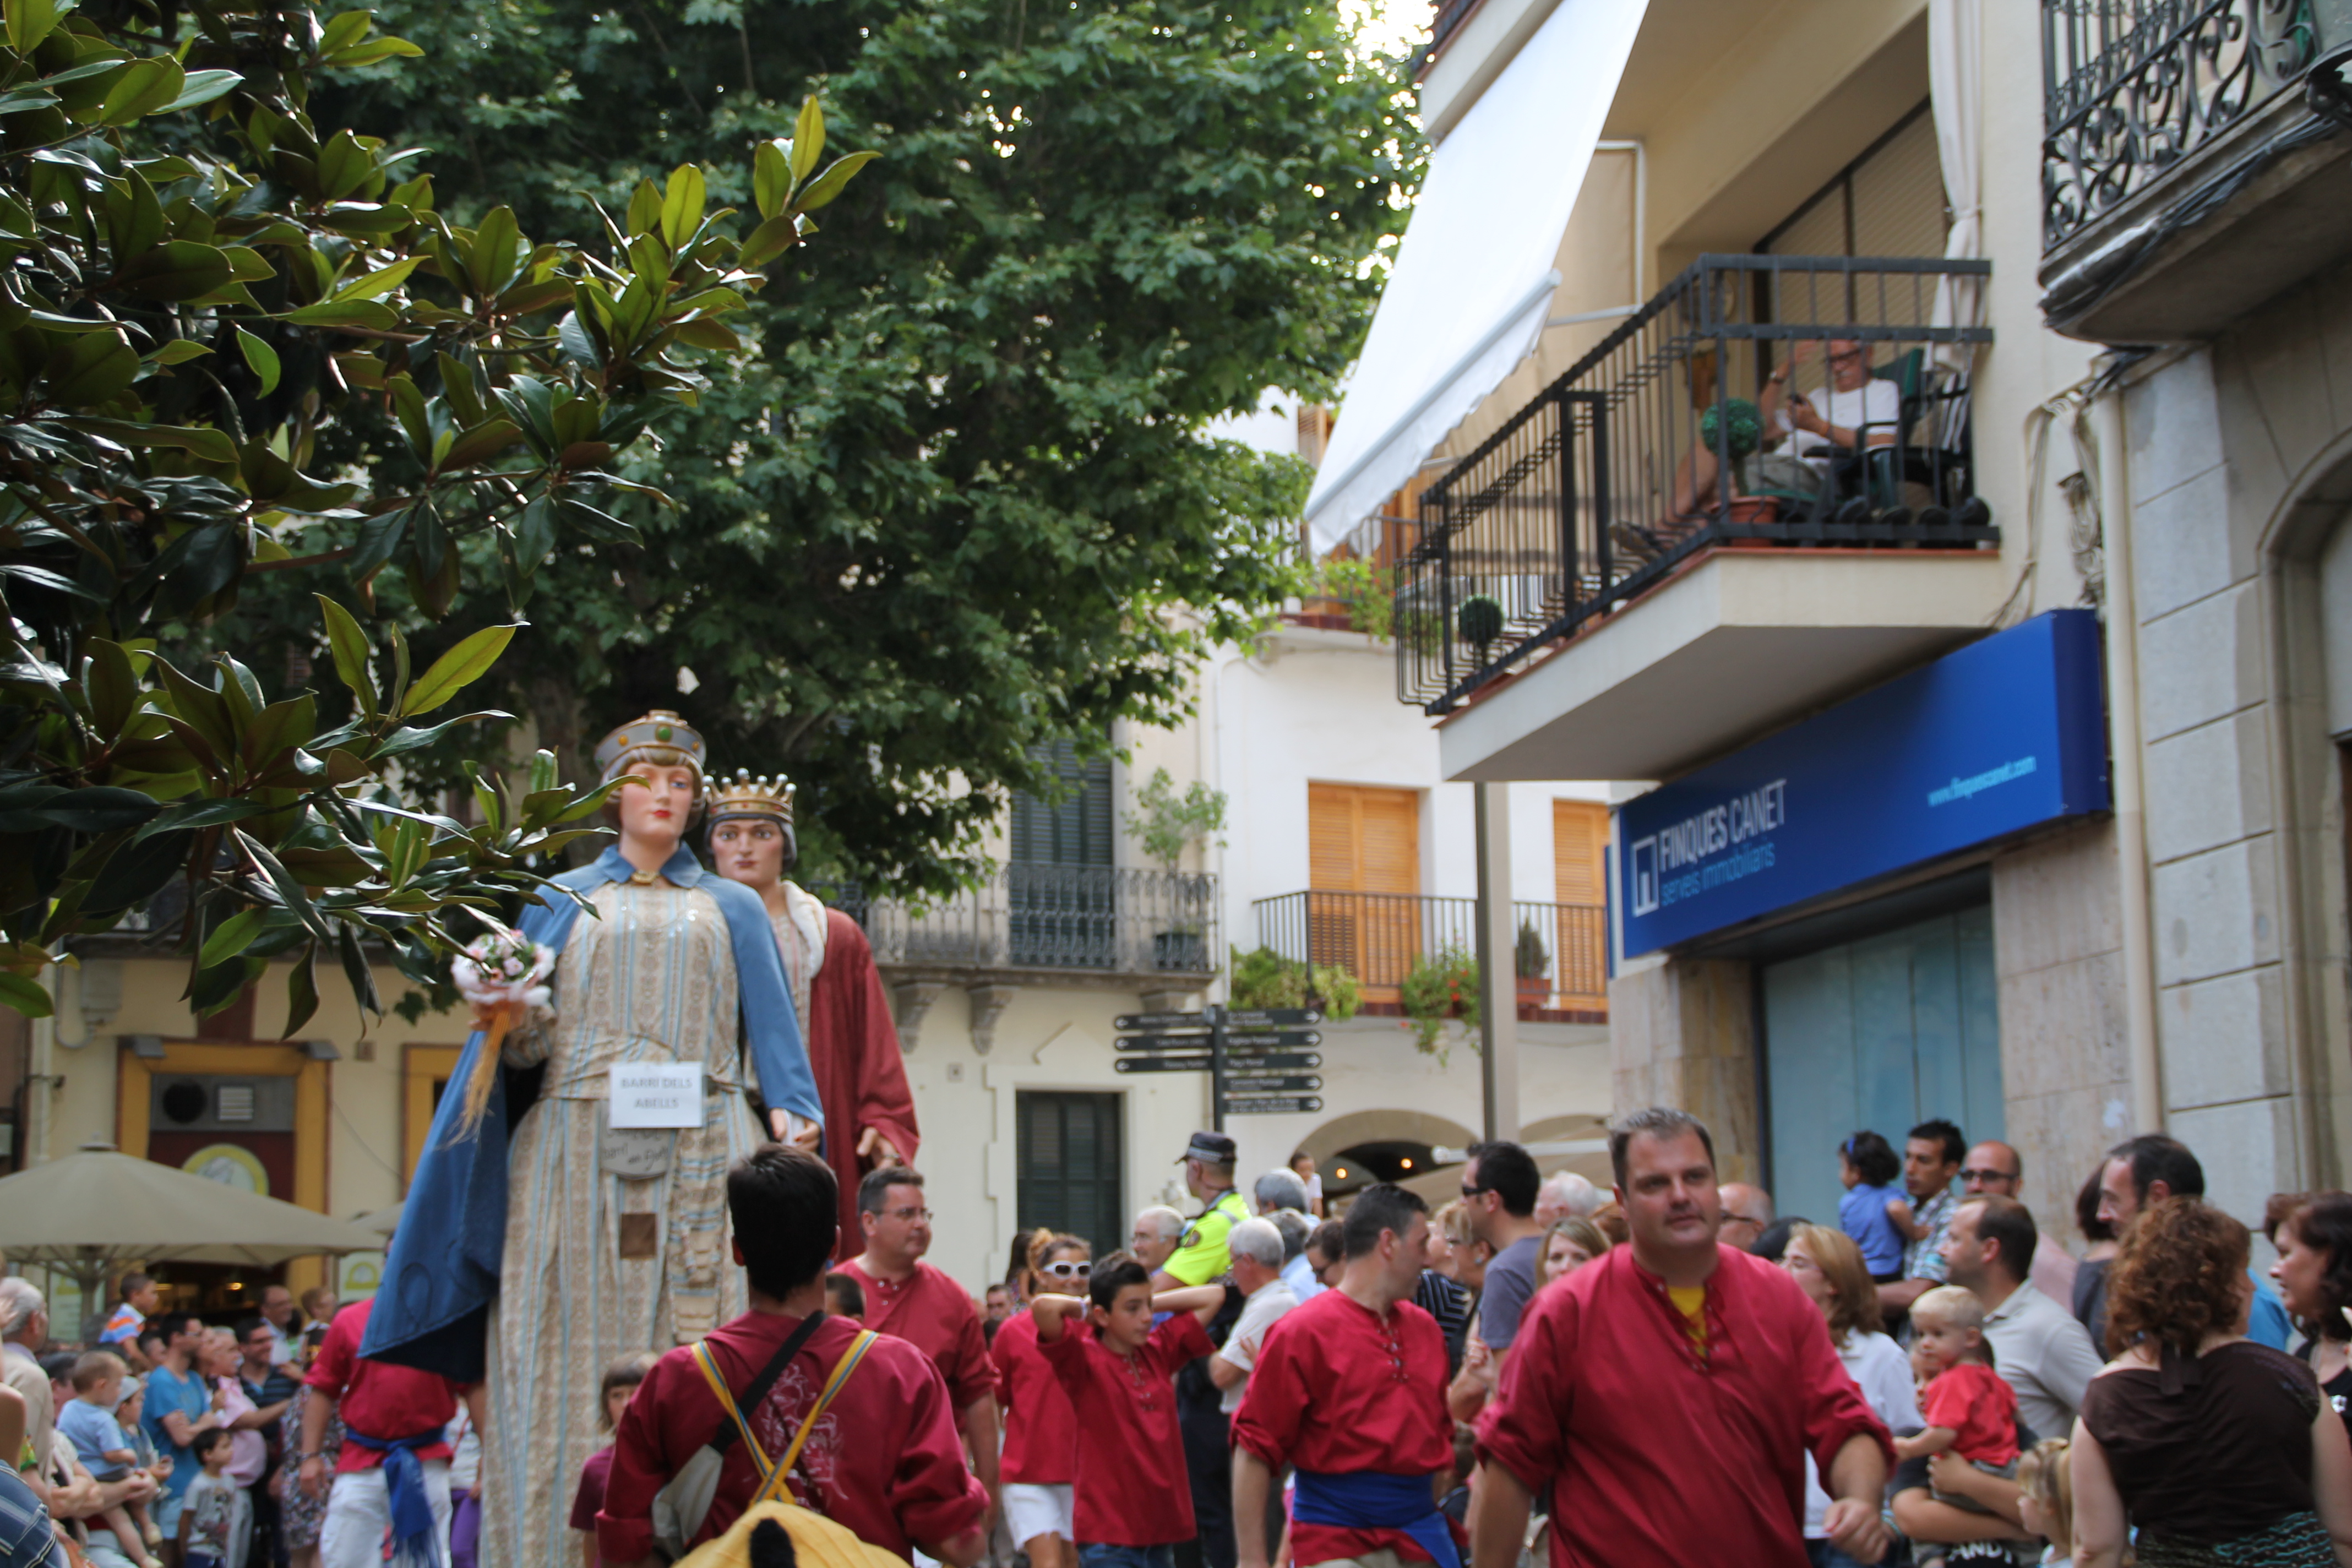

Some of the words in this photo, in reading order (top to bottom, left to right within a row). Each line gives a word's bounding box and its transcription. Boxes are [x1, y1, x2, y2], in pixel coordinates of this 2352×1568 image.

[1659, 804, 1728, 872] FINQUES
[1729, 778, 1787, 843] CANET
[621, 1077, 660, 1088] BARRI
[663, 1077, 693, 1088] DELS
